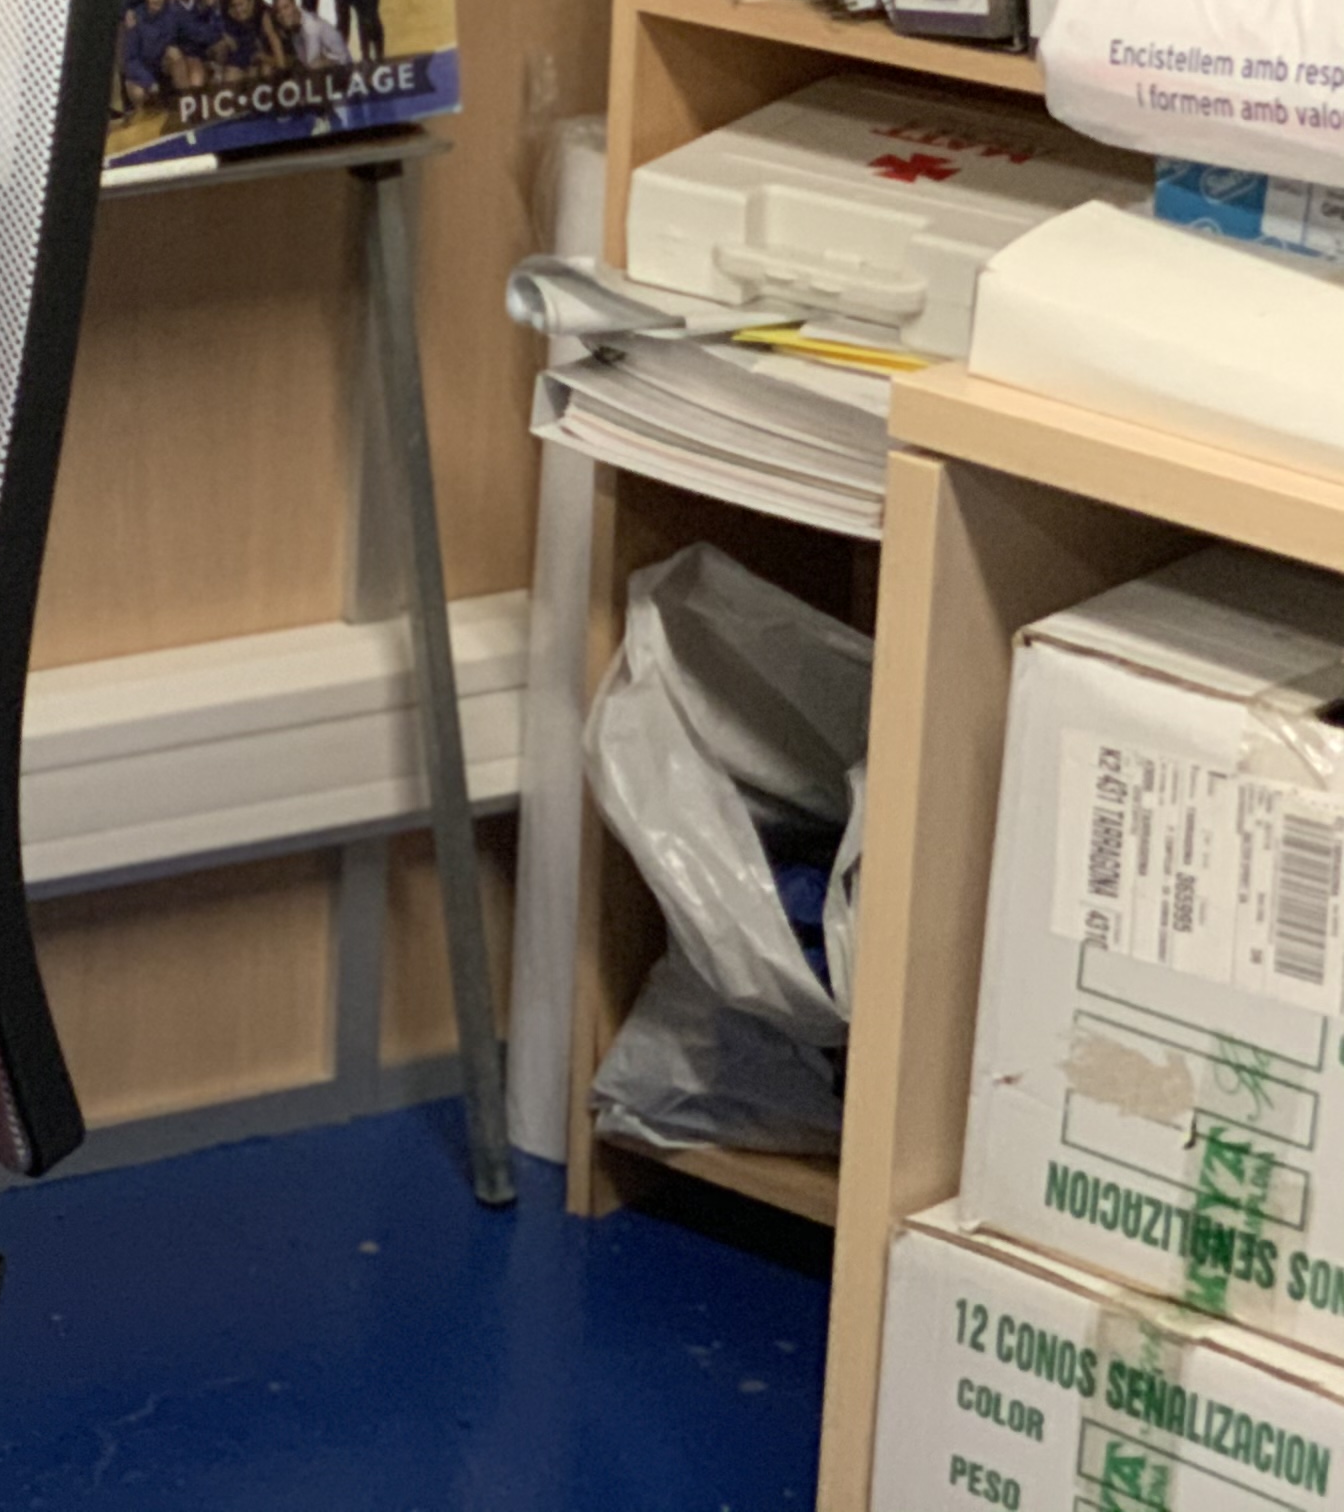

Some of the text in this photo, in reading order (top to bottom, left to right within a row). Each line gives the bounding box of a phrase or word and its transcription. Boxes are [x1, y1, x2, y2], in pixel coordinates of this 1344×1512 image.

[1109, 39, 1234, 76] Encistellem
[1241, 55, 1289, 82] amb
[1149, 84, 1234, 117] formem
[1241, 98, 1288, 125] amb
[1087, 805, 1125, 899] TARRAGONA
[955, 1297, 989, 1354] 12
[995, 1313, 1099, 1399] CONOS
[956, 1377, 1046, 1443] COLOR
[948, 1453, 1022, 1512] PESO
